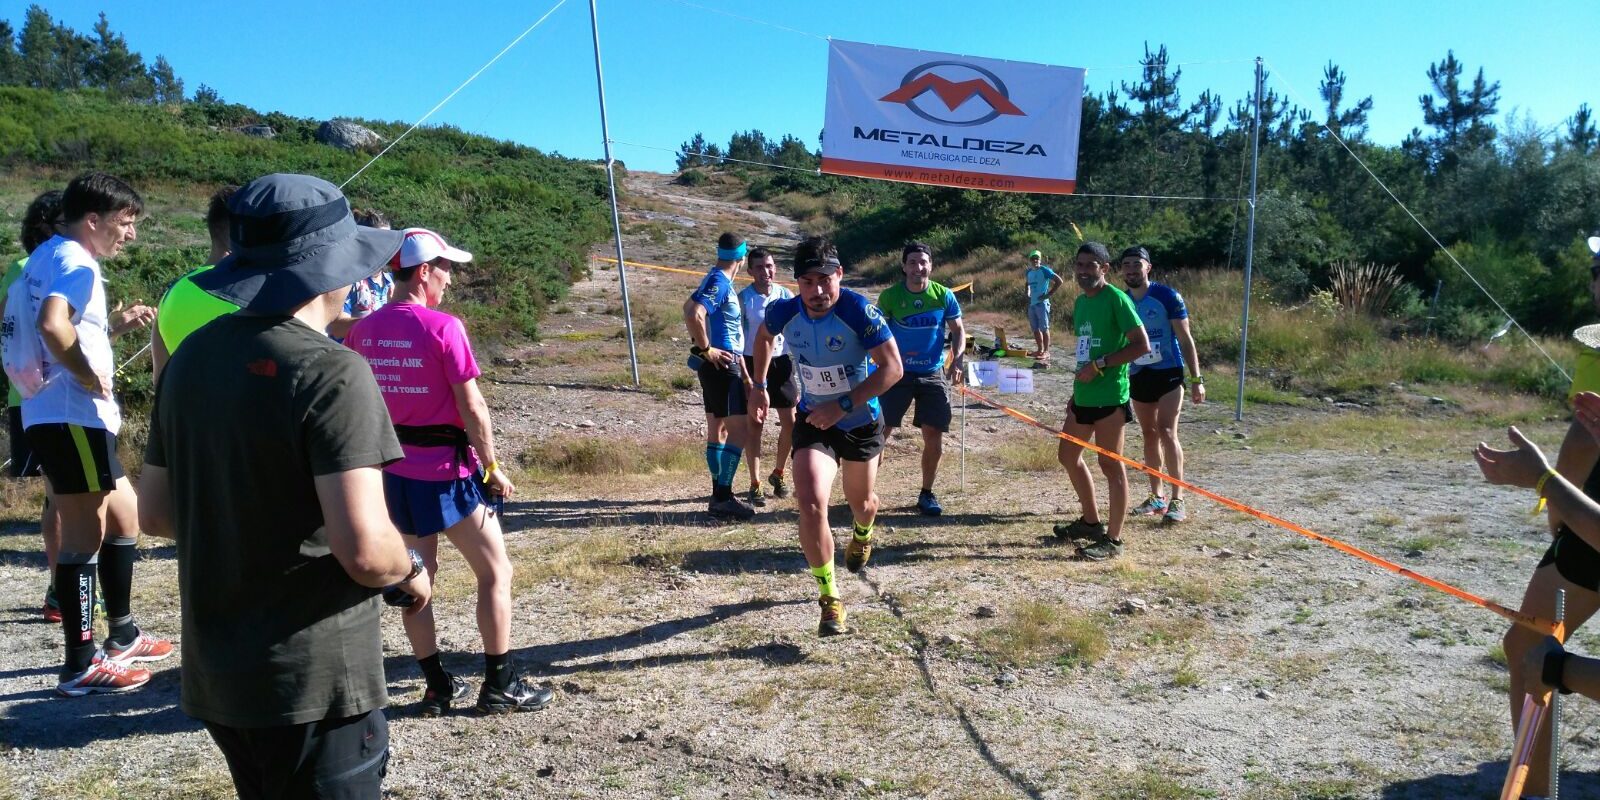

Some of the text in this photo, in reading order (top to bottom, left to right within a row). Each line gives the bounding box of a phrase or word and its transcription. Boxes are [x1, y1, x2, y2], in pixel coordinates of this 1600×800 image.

[853, 126, 1048, 157] METALDEZA
[901, 149, 1001, 167] METALÚRGICA DEL DEZA
[884, 168, 1015, 188] www.metaldeza.com
[377, 339, 412, 348] PORTOSIN
[402, 358, 423, 367] ANK
[375, 373, 401, 381] UTO-TAXI
[820, 370, 833, 382] 18
[79, 574, 89, 632] COMPRESPORT
